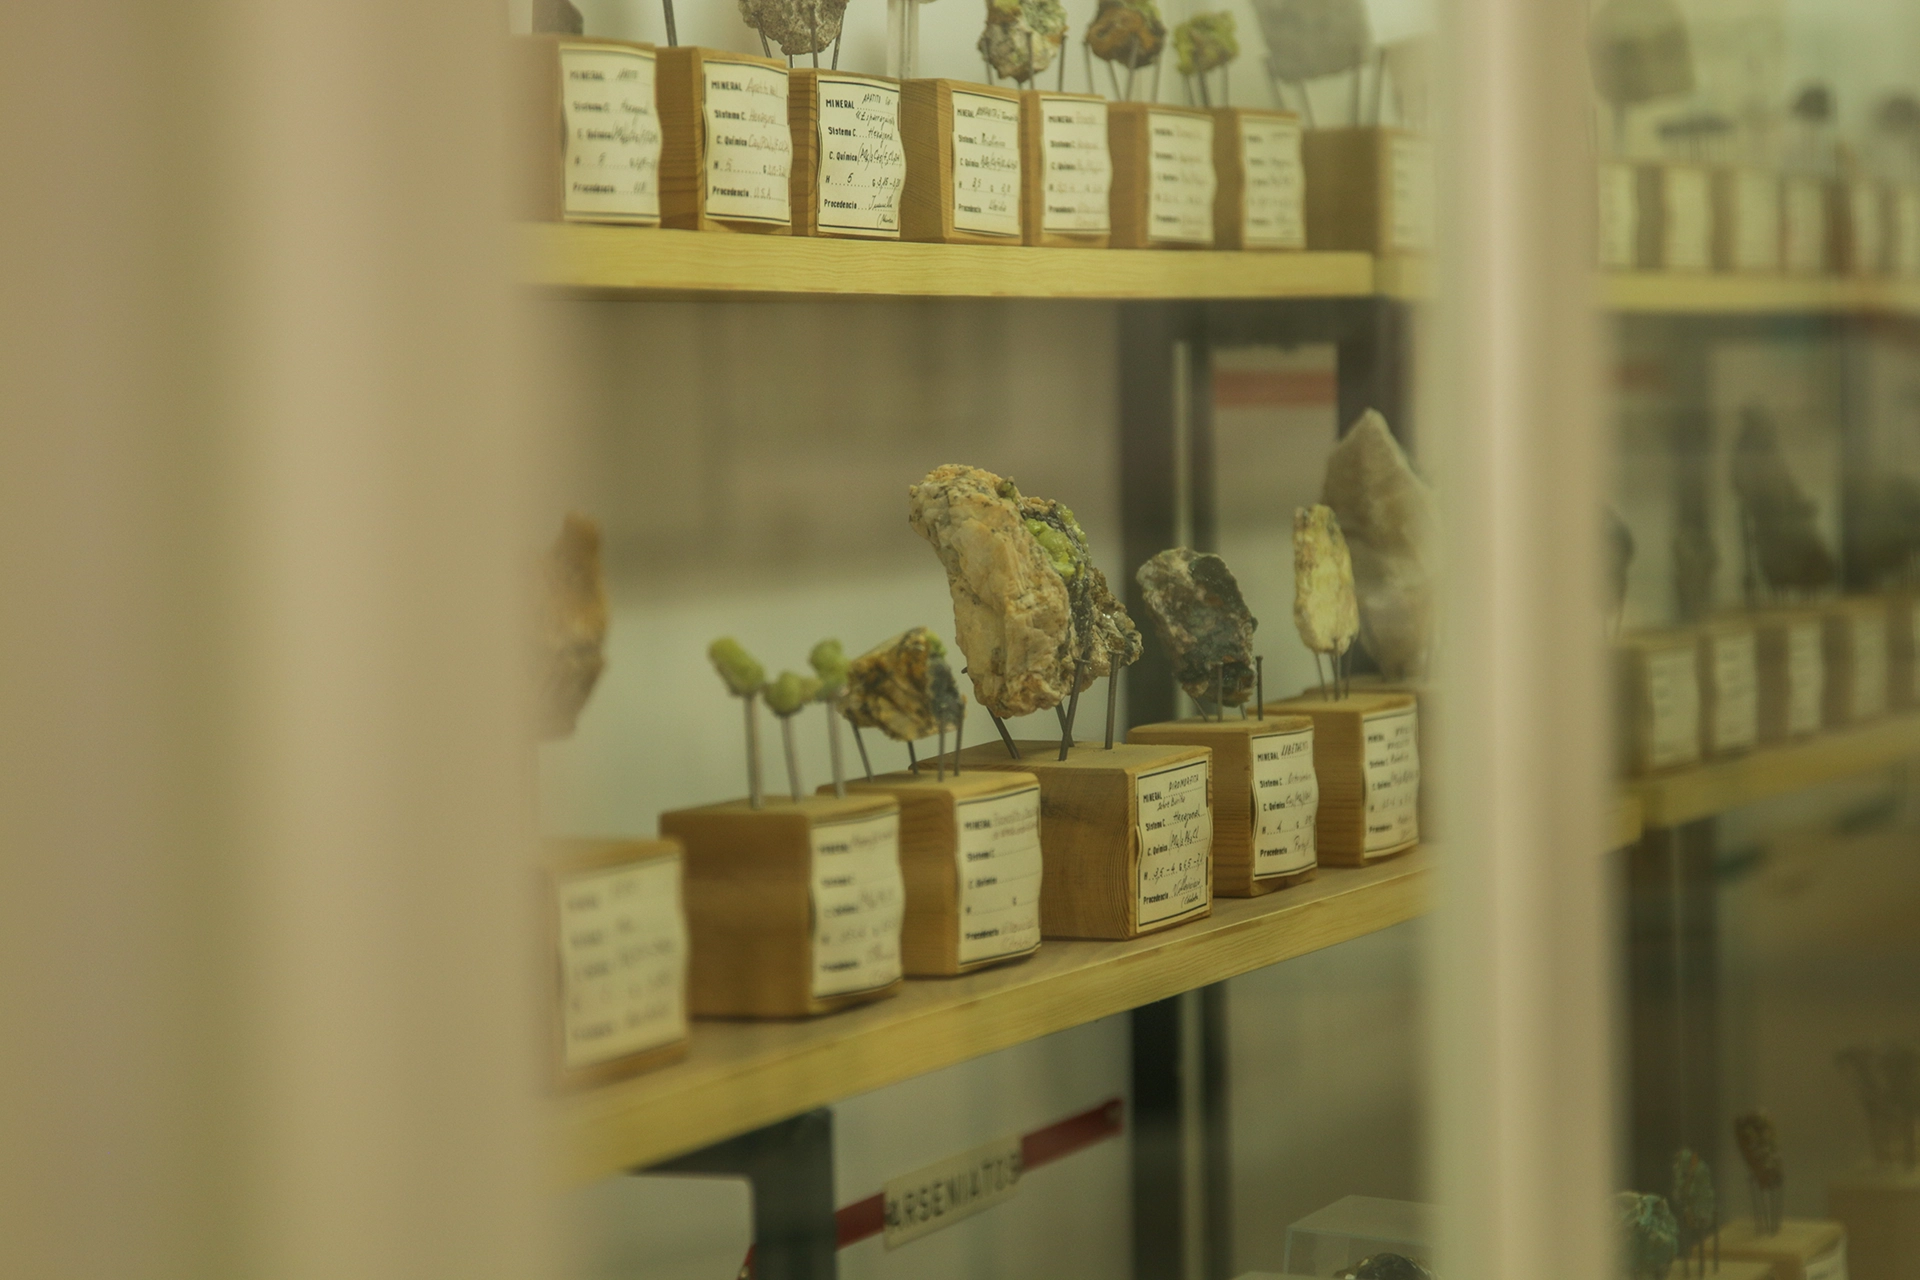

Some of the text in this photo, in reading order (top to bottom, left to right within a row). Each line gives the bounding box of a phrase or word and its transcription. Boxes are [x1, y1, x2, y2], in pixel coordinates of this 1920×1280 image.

[711, 80, 743, 92] MINERAL
[825, 99, 855, 110] MINERAL
[714, 109, 740, 120] Sistema
[957, 109, 975, 119] MINERAL
[828, 126, 852, 137] Sistema
[716, 134, 723, 145] C.
[724, 135, 748, 147] Químico
[829, 151, 835, 161] C.
[836, 151, 857, 162] Químico
[825, 175, 830, 183] H
[847, 173, 853, 183] 5
[712, 186, 750, 198] Procedencia
[824, 198, 857, 210] Procedencia
[1257, 752, 1280, 762] MINERAL
[1260, 779, 1279, 789] Sistema
[1143, 791, 1162, 803] MINERAL
[1145, 819, 1162, 831] Sistema
[1260, 848, 1288, 858] Procedencia
[1143, 891, 1169, 905] Procedencia
